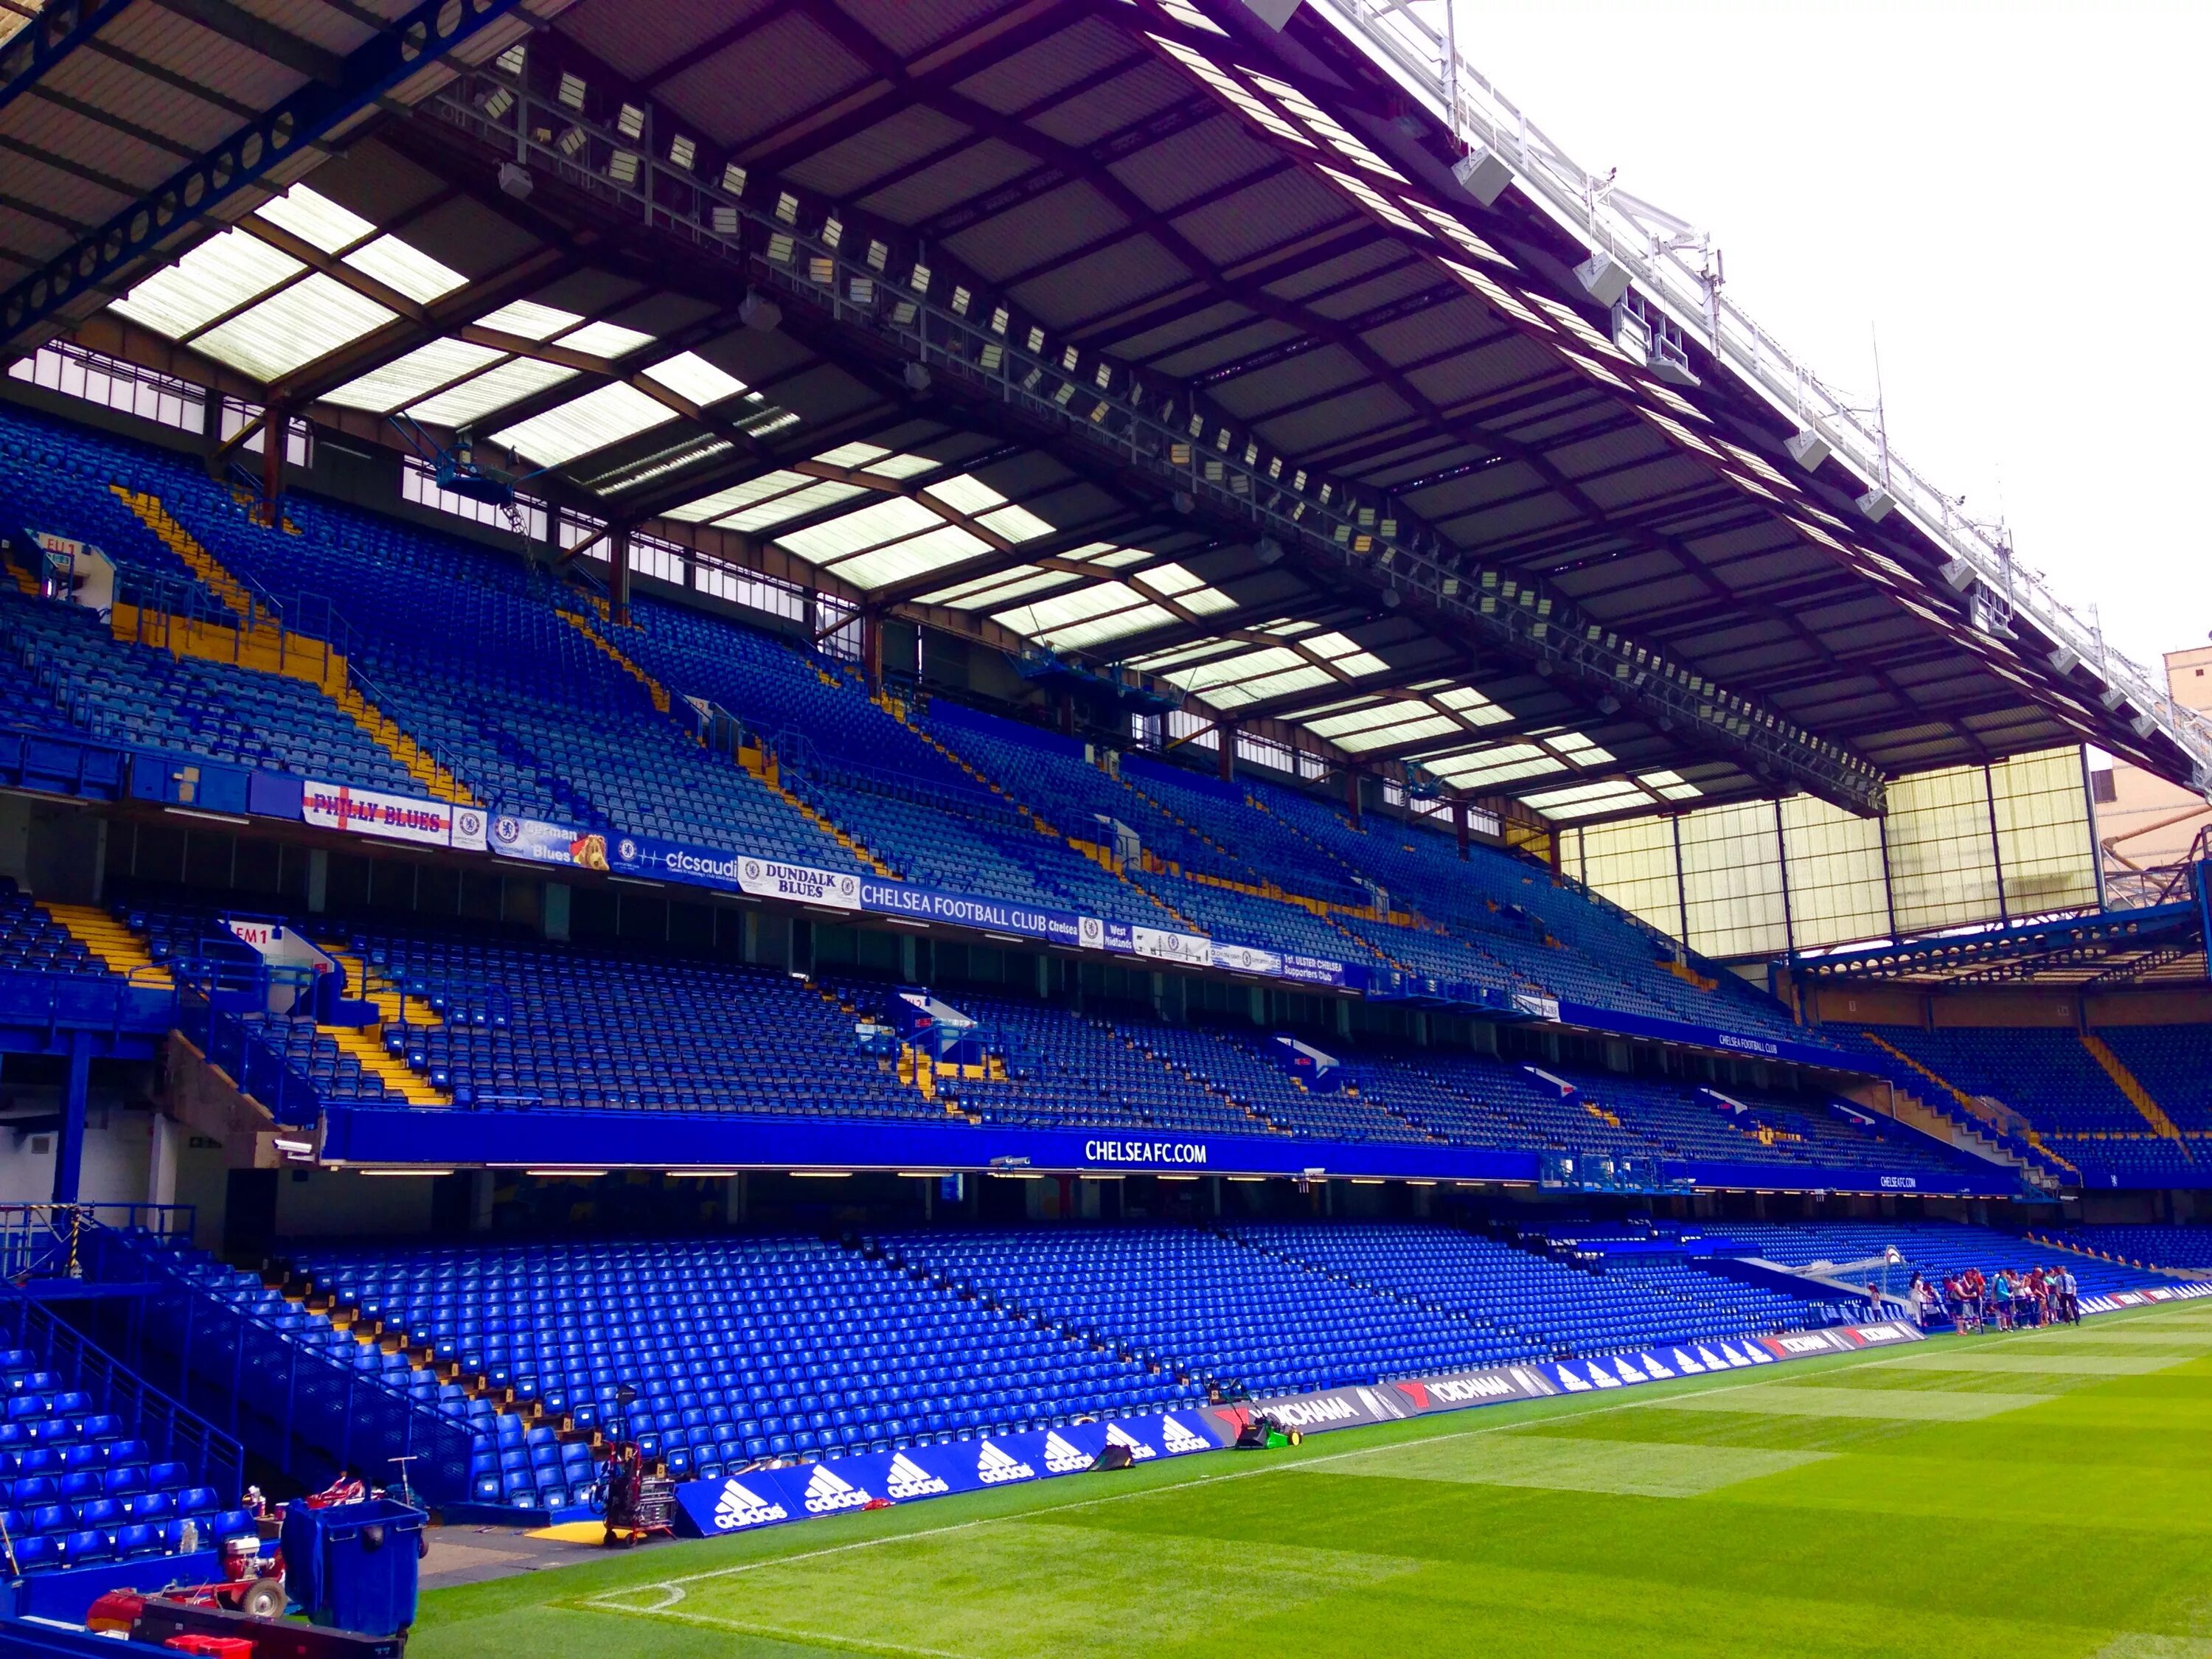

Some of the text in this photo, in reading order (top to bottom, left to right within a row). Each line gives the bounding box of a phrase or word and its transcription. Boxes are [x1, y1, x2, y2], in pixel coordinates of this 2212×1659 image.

[313, 793, 440, 832] PHILLY BLUES
[524, 820, 577, 841] German
[532, 844, 571, 862] Blues
[666, 851, 737, 878] cfcsaudi
[766, 864, 835, 887] DUNDALK
[779, 880, 824, 898] BLUES
[861, 885, 1046, 931] CHELSEA FOOTBALL CLUB
[260, 930, 267, 944] 1
[1048, 919, 1078, 936] Chelsea
[1110, 925, 1126, 935] West
[1105, 935, 1133, 949] Midlands
[1284, 965, 1332, 981] Supporters Club
[1295, 956, 1316, 968] ULSTER
[1317, 960, 1343, 972] CHELSEA
[1719, 1034, 1778, 1054] CHELSEA FOOTBALL CLUB
[1085, 1140, 1207, 1163] CHELSEAFC.COM
[1424, 1375, 1516, 1402] YOKOHAMA
[1165, 1437, 1211, 1453] adidas
[978, 1464, 1035, 1484] adidas
[887, 1478, 949, 1498] adidas
[804, 1490, 872, 1512] adidas
[714, 1505, 788, 1529] adidas
